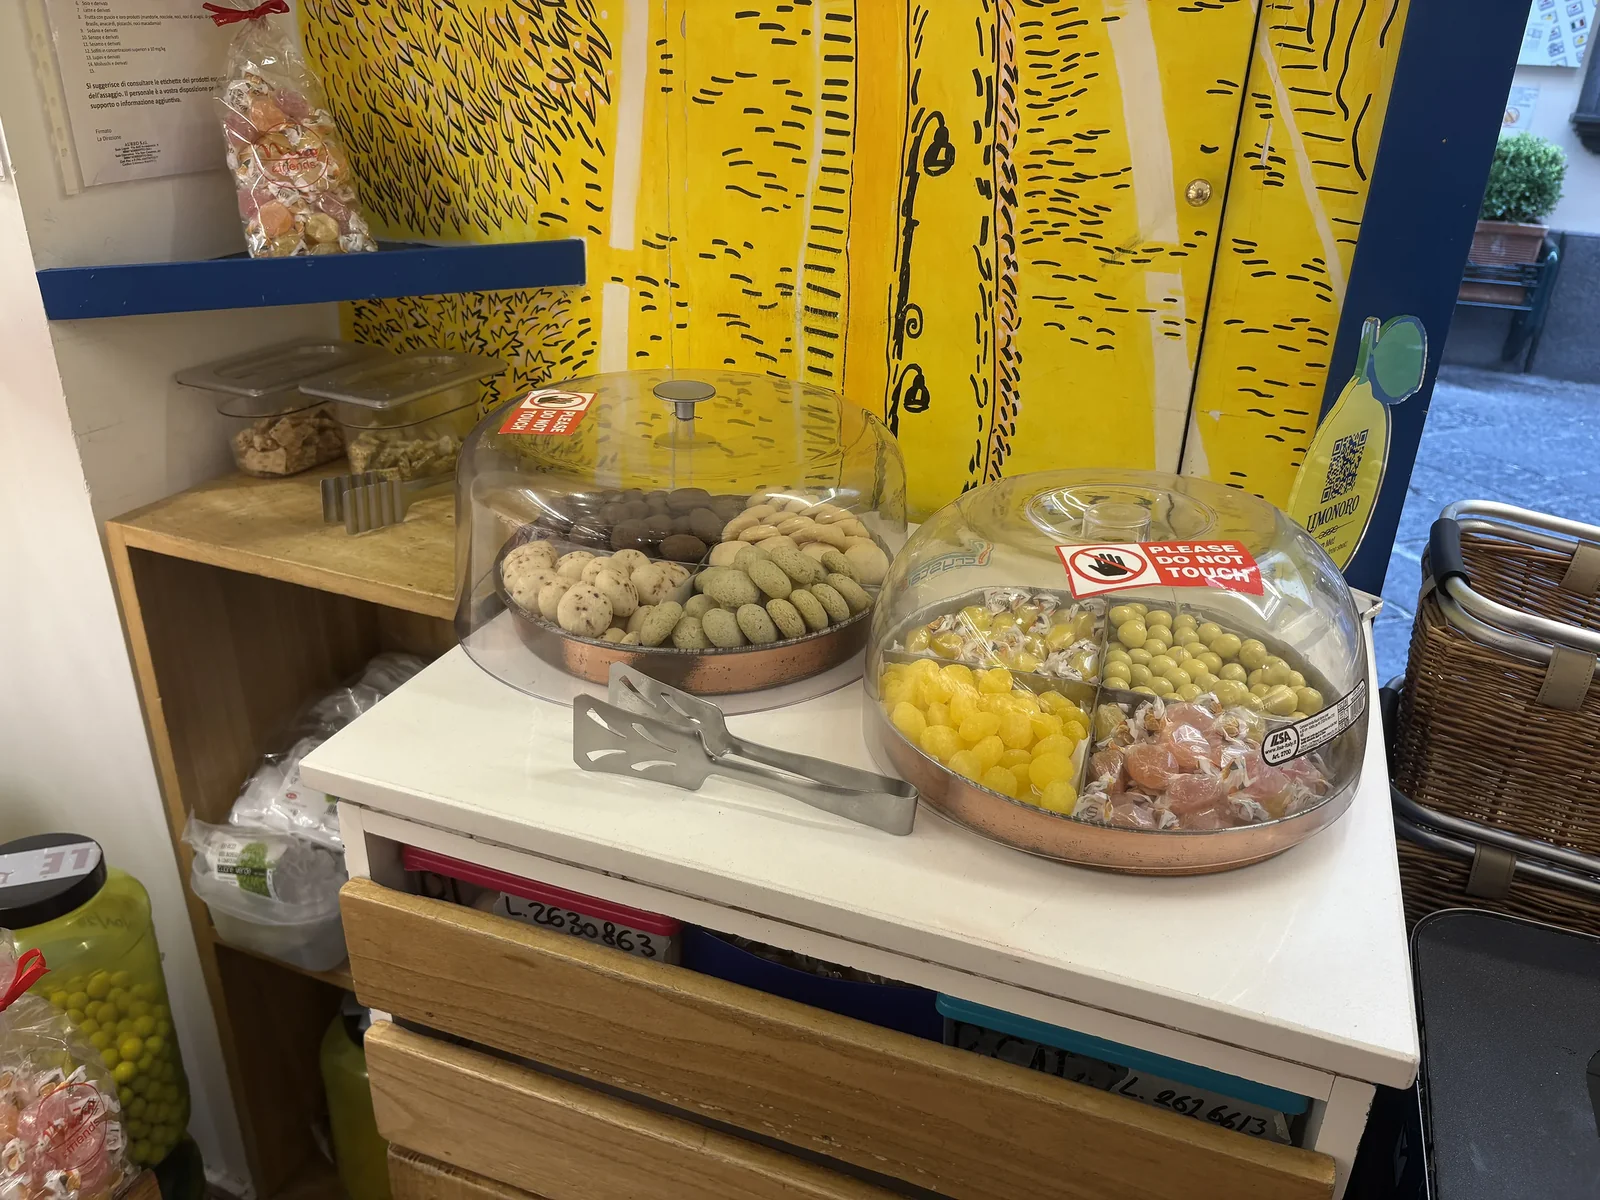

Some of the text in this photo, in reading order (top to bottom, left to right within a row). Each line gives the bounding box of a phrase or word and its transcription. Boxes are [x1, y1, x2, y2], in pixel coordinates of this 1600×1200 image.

[92, 82, 120, 90] suggerisce
[191, 76, 210, 84] prodotti
[88, 91, 124, 100] dell'assaggio.
[129, 89, 154, 97] personale
[90, 102, 115, 110] supporto
[120, 98, 155, 107] informazione
[155, 96, 182, 105] aggiuntiva.
[510, 410, 537, 431] TOUCH
[530, 410, 558, 432] DO NOT
[550, 411, 577, 433] PLEASE
[1306, 494, 1360, 534] LIMONORO
[1148, 544, 1239, 554] PLEASE
[1155, 555, 1244, 565] DO NOT
[1164, 565, 1250, 583] TOUCH
[1270, 731, 1292, 748] ILSA
